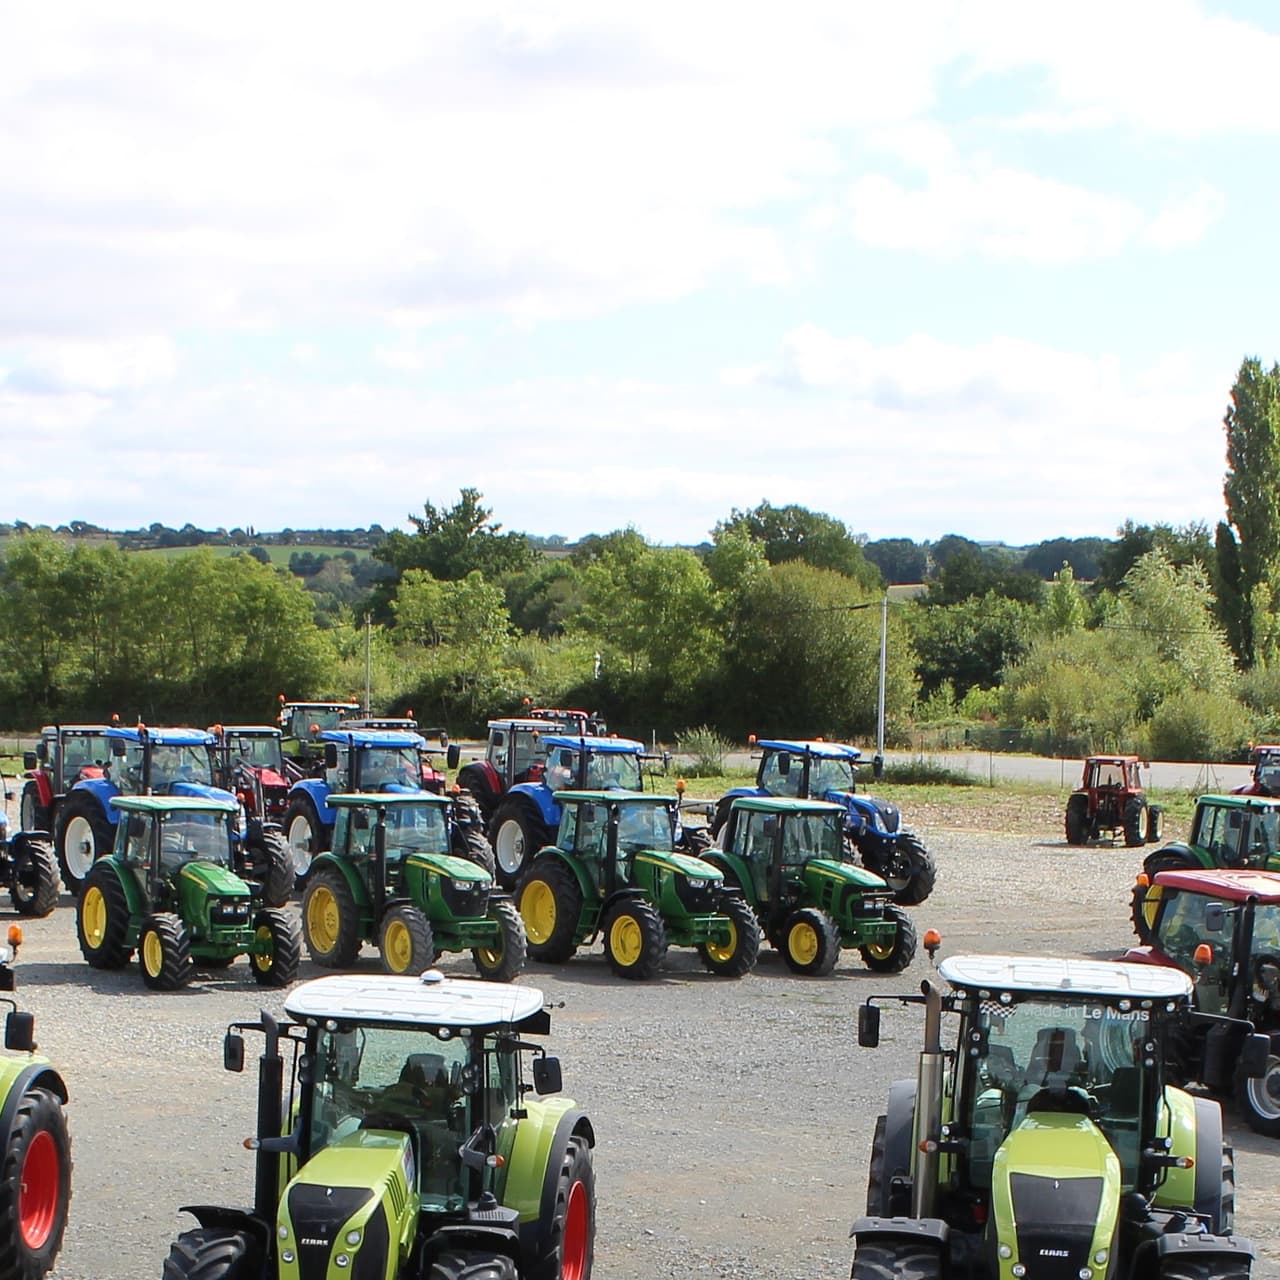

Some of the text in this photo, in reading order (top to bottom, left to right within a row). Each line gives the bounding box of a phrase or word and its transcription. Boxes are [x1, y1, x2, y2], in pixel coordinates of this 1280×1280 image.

[1082, 1005, 1102, 1019] Le
[1106, 1006, 1150, 1021] Mans
[301, 1238, 329, 1246] CLAAS
[1040, 1249, 1070, 1257] CLAAS
